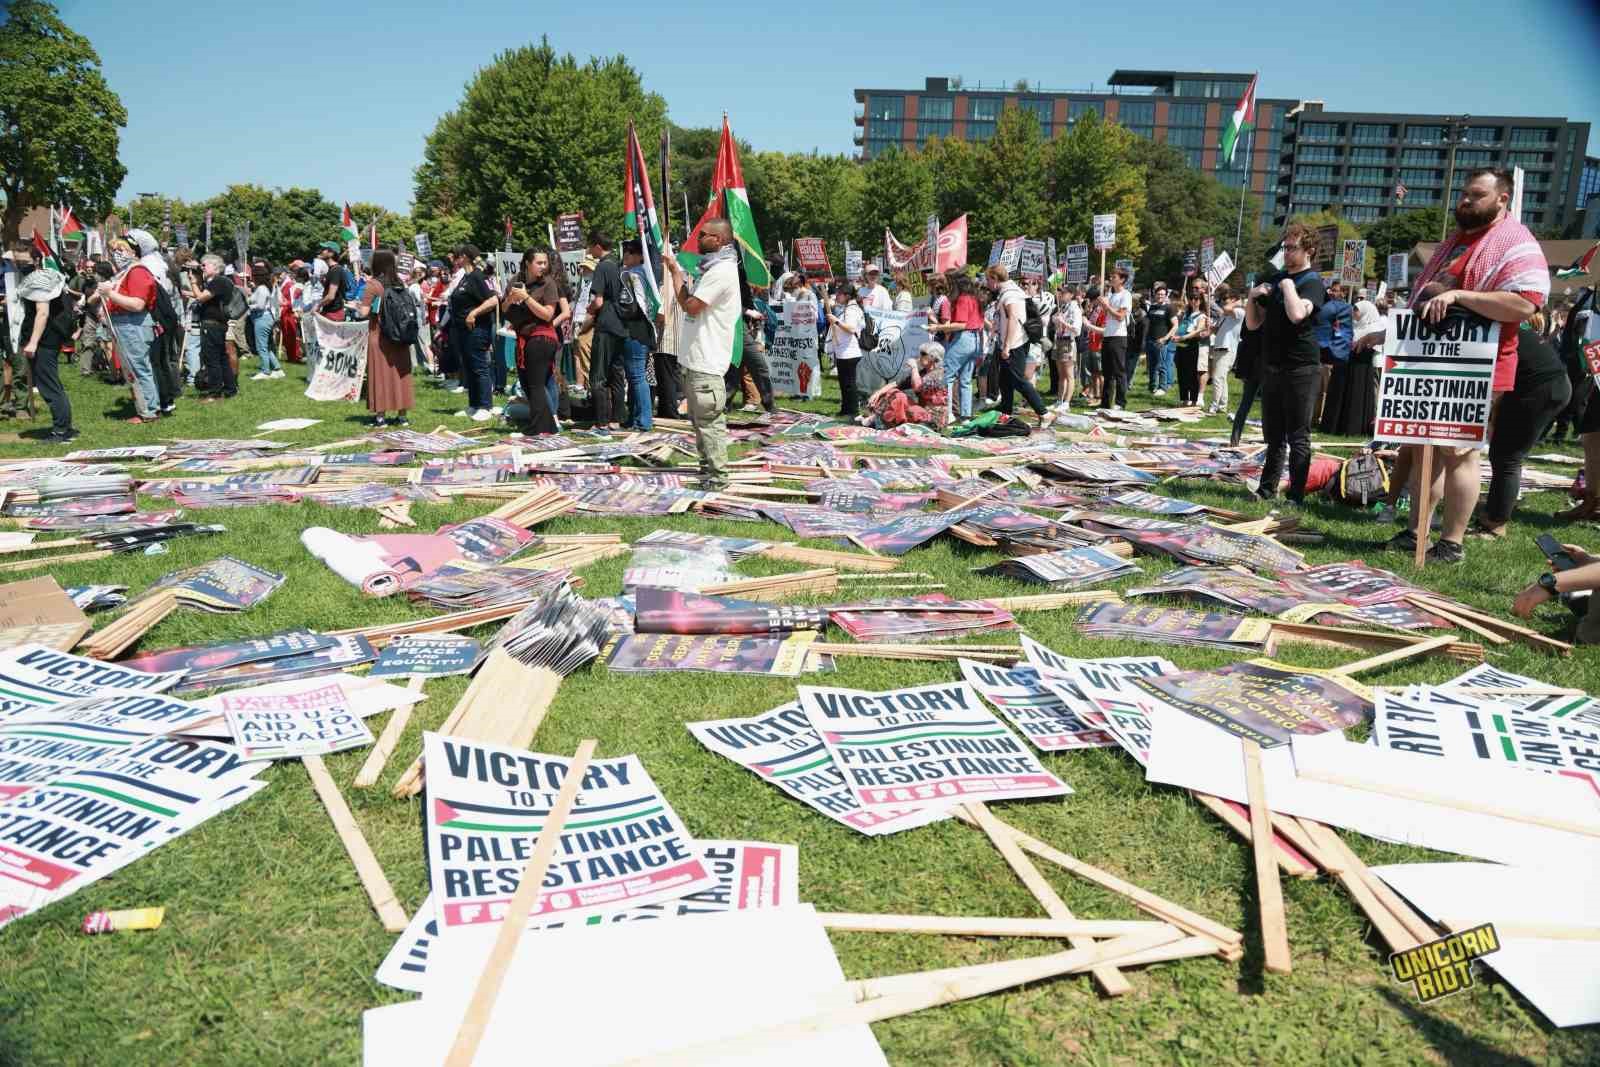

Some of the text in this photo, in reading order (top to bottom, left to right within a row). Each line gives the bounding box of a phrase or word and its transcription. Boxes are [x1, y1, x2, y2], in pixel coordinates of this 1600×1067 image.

[1422, 342, 1461, 356] TO THE
[1384, 377, 1489, 400] PALESTINIAN
[1381, 399, 1486, 423] RESISTANCE
[16, 650, 175, 689] VICTORY
[382, 659, 465, 667] EQUALITY!
[37, 676, 101, 695] TO THE
[814, 687, 970, 719] VICTORY
[242, 714, 352, 732] AID TO
[875, 711, 942, 728] TO THE
[244, 723, 359, 742] ISRAEL!
[782, 738, 809, 751] TO
[837, 736, 1022, 765] PALESTINIAN
[118, 759, 164, 779] THE
[443, 741, 632, 793] VICTORY
[850, 757, 1042, 786] RESISTANCE
[506, 789, 586, 808] TO TE
[440, 815, 675, 862] PALETINIAN
[444, 836, 692, 898] RESSTANCE
